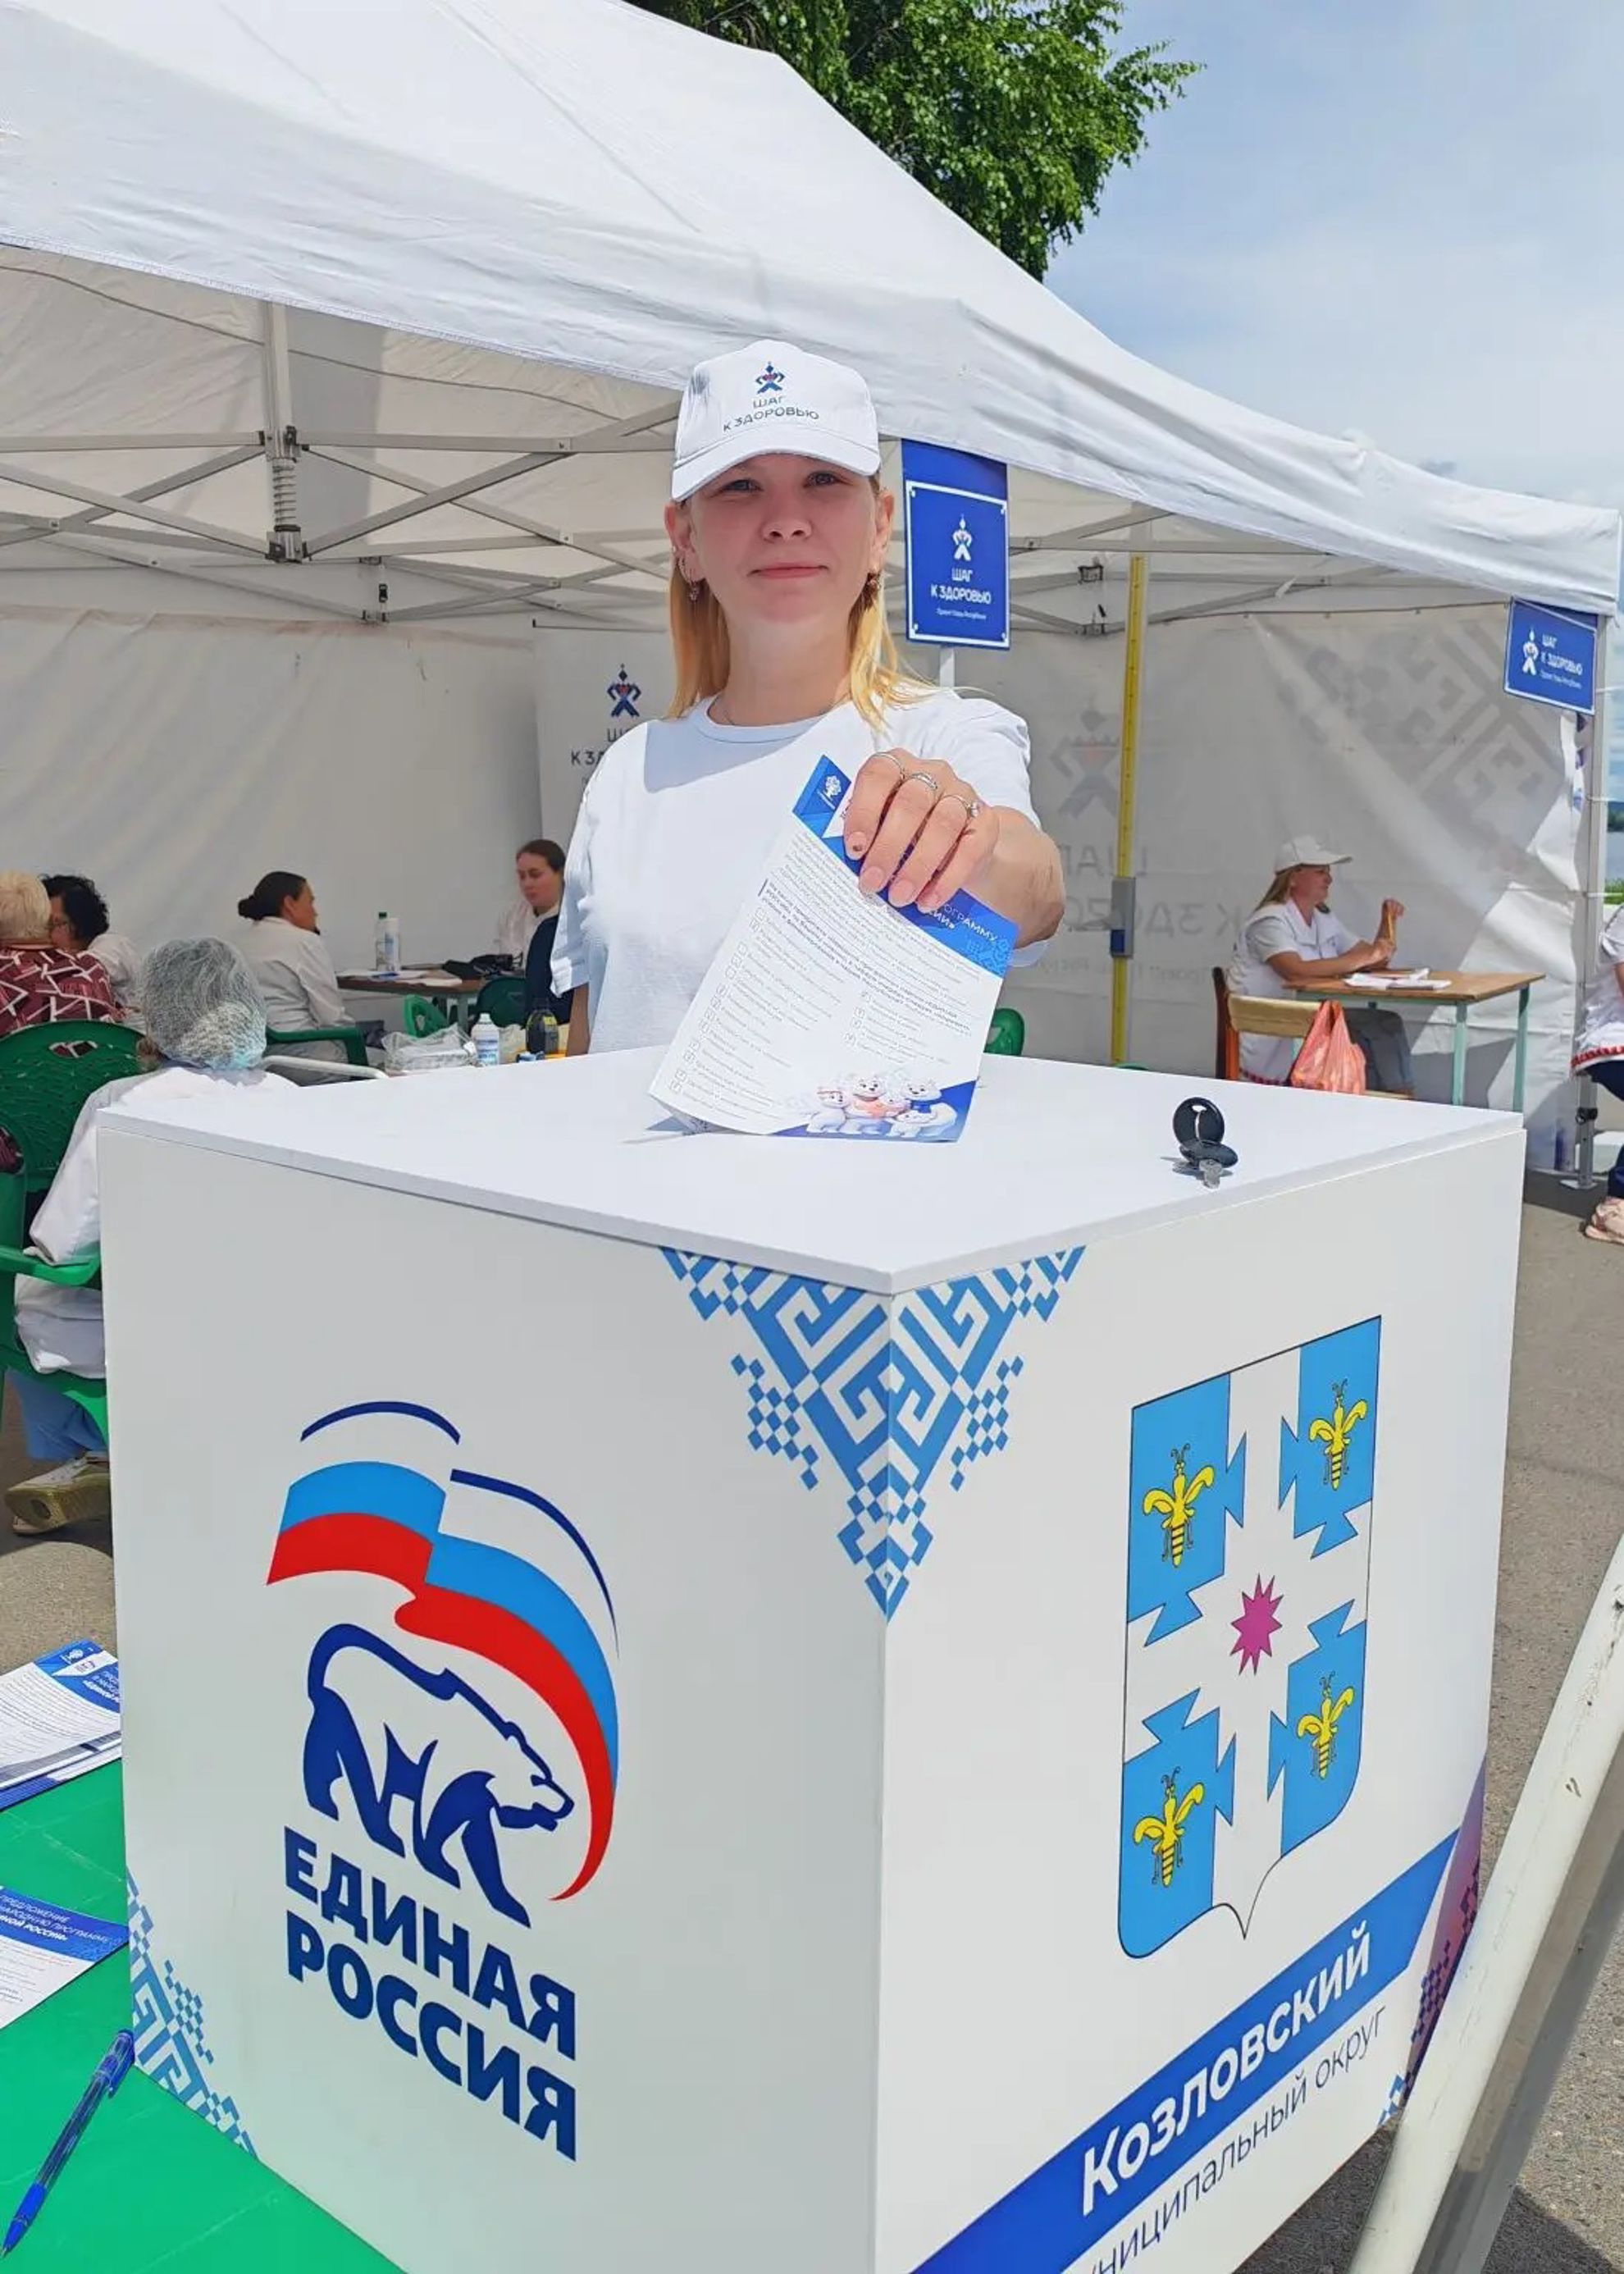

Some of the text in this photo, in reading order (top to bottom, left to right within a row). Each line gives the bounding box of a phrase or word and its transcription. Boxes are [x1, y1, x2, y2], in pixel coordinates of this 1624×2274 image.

[723, 407, 819, 432] К ЗДОРОВЬЮ
[753, 396, 784, 409] ШАГ
[931, 583, 992, 605] К ЗДОРОВЬЮ
[951, 568, 973, 582] ШАГ
[943, 903, 999, 943] ОГРАММУ
[285, 1826, 576, 2062] ЕДИНАЯ
[286, 1910, 577, 2162] РОССИЯ
[1083, 1920, 1371, 2217] Козловский
[1093, 2005, 1386, 2274] ниципальный округ
